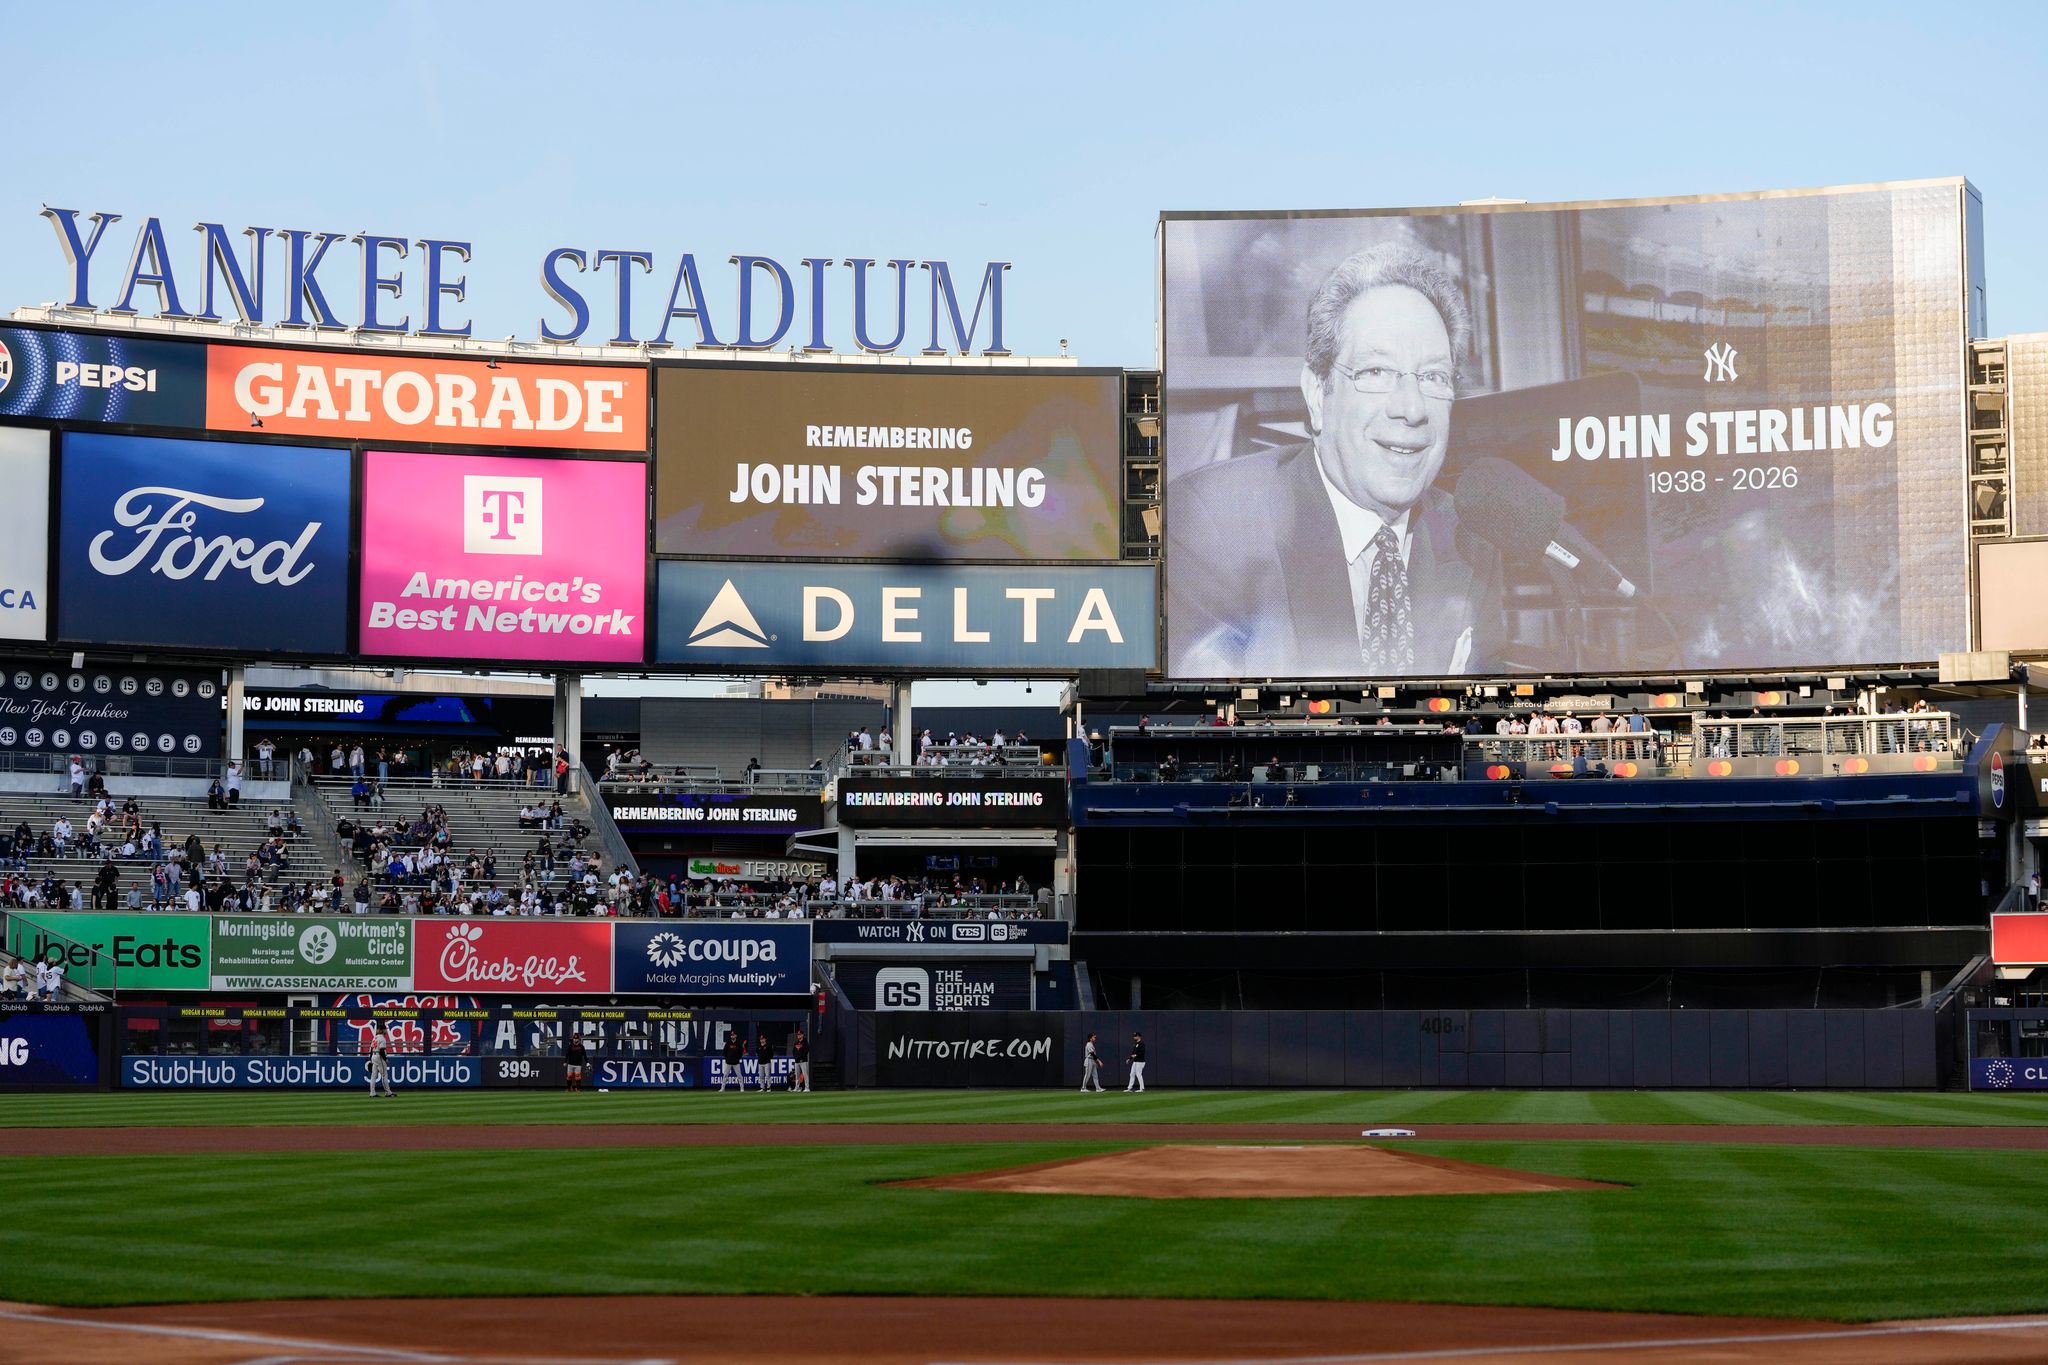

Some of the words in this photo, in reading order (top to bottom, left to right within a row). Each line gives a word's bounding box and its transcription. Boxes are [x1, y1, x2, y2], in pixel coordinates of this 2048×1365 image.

[41, 207, 472, 336] YANKEE
[540, 248, 1012, 355] STADIUM
[56, 361, 156, 392] PEPSI
[234, 363, 624, 433] GATORADE
[806, 425, 972, 450] REMEMBERING
[1552, 414, 1671, 462] JOHN
[1686, 403, 1894, 457] STERLING
[729, 463, 840, 505] JOHN
[856, 465, 1046, 509] STERLING
[1648, 469, 1706, 494] 1938
[1732, 467, 1798, 492] 2026
[89, 487, 322, 587] Ford
[401, 571, 601, 604] America's
[368, 602, 458, 632] Best
[466, 607, 634, 636] Network
[803, 586, 1124, 644] DELTA
[16, 675, 29, 686] 37
[46, 677, 53, 687] 8
[73, 678, 79, 688] 8
[97, 679, 108, 689] 16
[124, 680, 134, 690] 15
[149, 681, 161, 691] 32
[177, 683, 183, 693] 9
[201, 684, 212, 694] 10
[0, 697, 29, 714] New
[30, 699, 68, 723] York
[69, 701, 129, 724] Yankees
[264, 697, 300, 712] JOHN
[304, 698, 364, 713] STERLING
[1575, 700, 1589, 709] Eye
[1590, 698, 1610, 707] Deck
[1, 731, 14, 741] 49
[28, 732, 40, 742] 42
[58, 733, 64, 743] 6
[82, 734, 93, 744] 51
[108, 735, 120, 746] 46
[134, 736, 147, 747] 20
[163, 738, 170, 748] 2
[187, 739, 198, 749] 21
[846, 792, 943, 806] REMEMBERING
[946, 793, 981, 806] JOHN
[984, 792, 1043, 806] STERLING
[613, 807, 704, 820] REMEMBERING
[707, 808, 739, 821] JOHN
[742, 808, 797, 822] STERLING
[744, 861, 822, 878] TERRACE
[219, 920, 295, 940] Morningside
[338, 921, 405, 938] Workmen's
[858, 926, 900, 938] WATCH
[930, 926, 946, 938] ON
[957, 927, 980, 936] YES
[113, 936, 201, 968] Eats
[252, 949, 279, 957] Nursing
[282, 948, 294, 956] and
[368, 938, 404, 955] Circle
[688, 938, 776, 969] coupa
[219, 957, 269, 965] Rehabilitation
[270, 957, 294, 965] Center
[345, 958, 379, 966] MultiCare
[381, 958, 404, 966] Center
[440, 937, 586, 988] Chick-fil-A
[226, 977, 398, 988] WWW.CASSENACARE.COM
[646, 973, 677, 983] Make
[679, 973, 725, 987] Margins
[936, 970, 963, 982] THE
[884, 981, 921, 1007] GS
[935, 982, 994, 994] GOTHAM
[78, 1004, 105, 1012] StubHub
[935, 994, 990, 1006] SPORTS
[181, 1008, 200, 1016] MORGAN
[205, 1008, 225, 1016] MORGAN
[243, 1009, 262, 1017] MORGAN
[267, 1009, 285, 1017] MORGAN
[444, 1010, 463, 1018] MORGAN
[469, 1010, 489, 1018] MORGAN
[648, 1011, 667, 1019] MORGAN
[672, 1011, 691, 1019] MORGAN
[888, 1034, 1051, 1062] NITTOTIRE.COM
[133, 1060, 236, 1084] StubHub
[247, 1060, 352, 1084] StubHub
[499, 1060, 530, 1079] 399
[531, 1070, 539, 1078] FT
[601, 1060, 685, 1083] STARR
